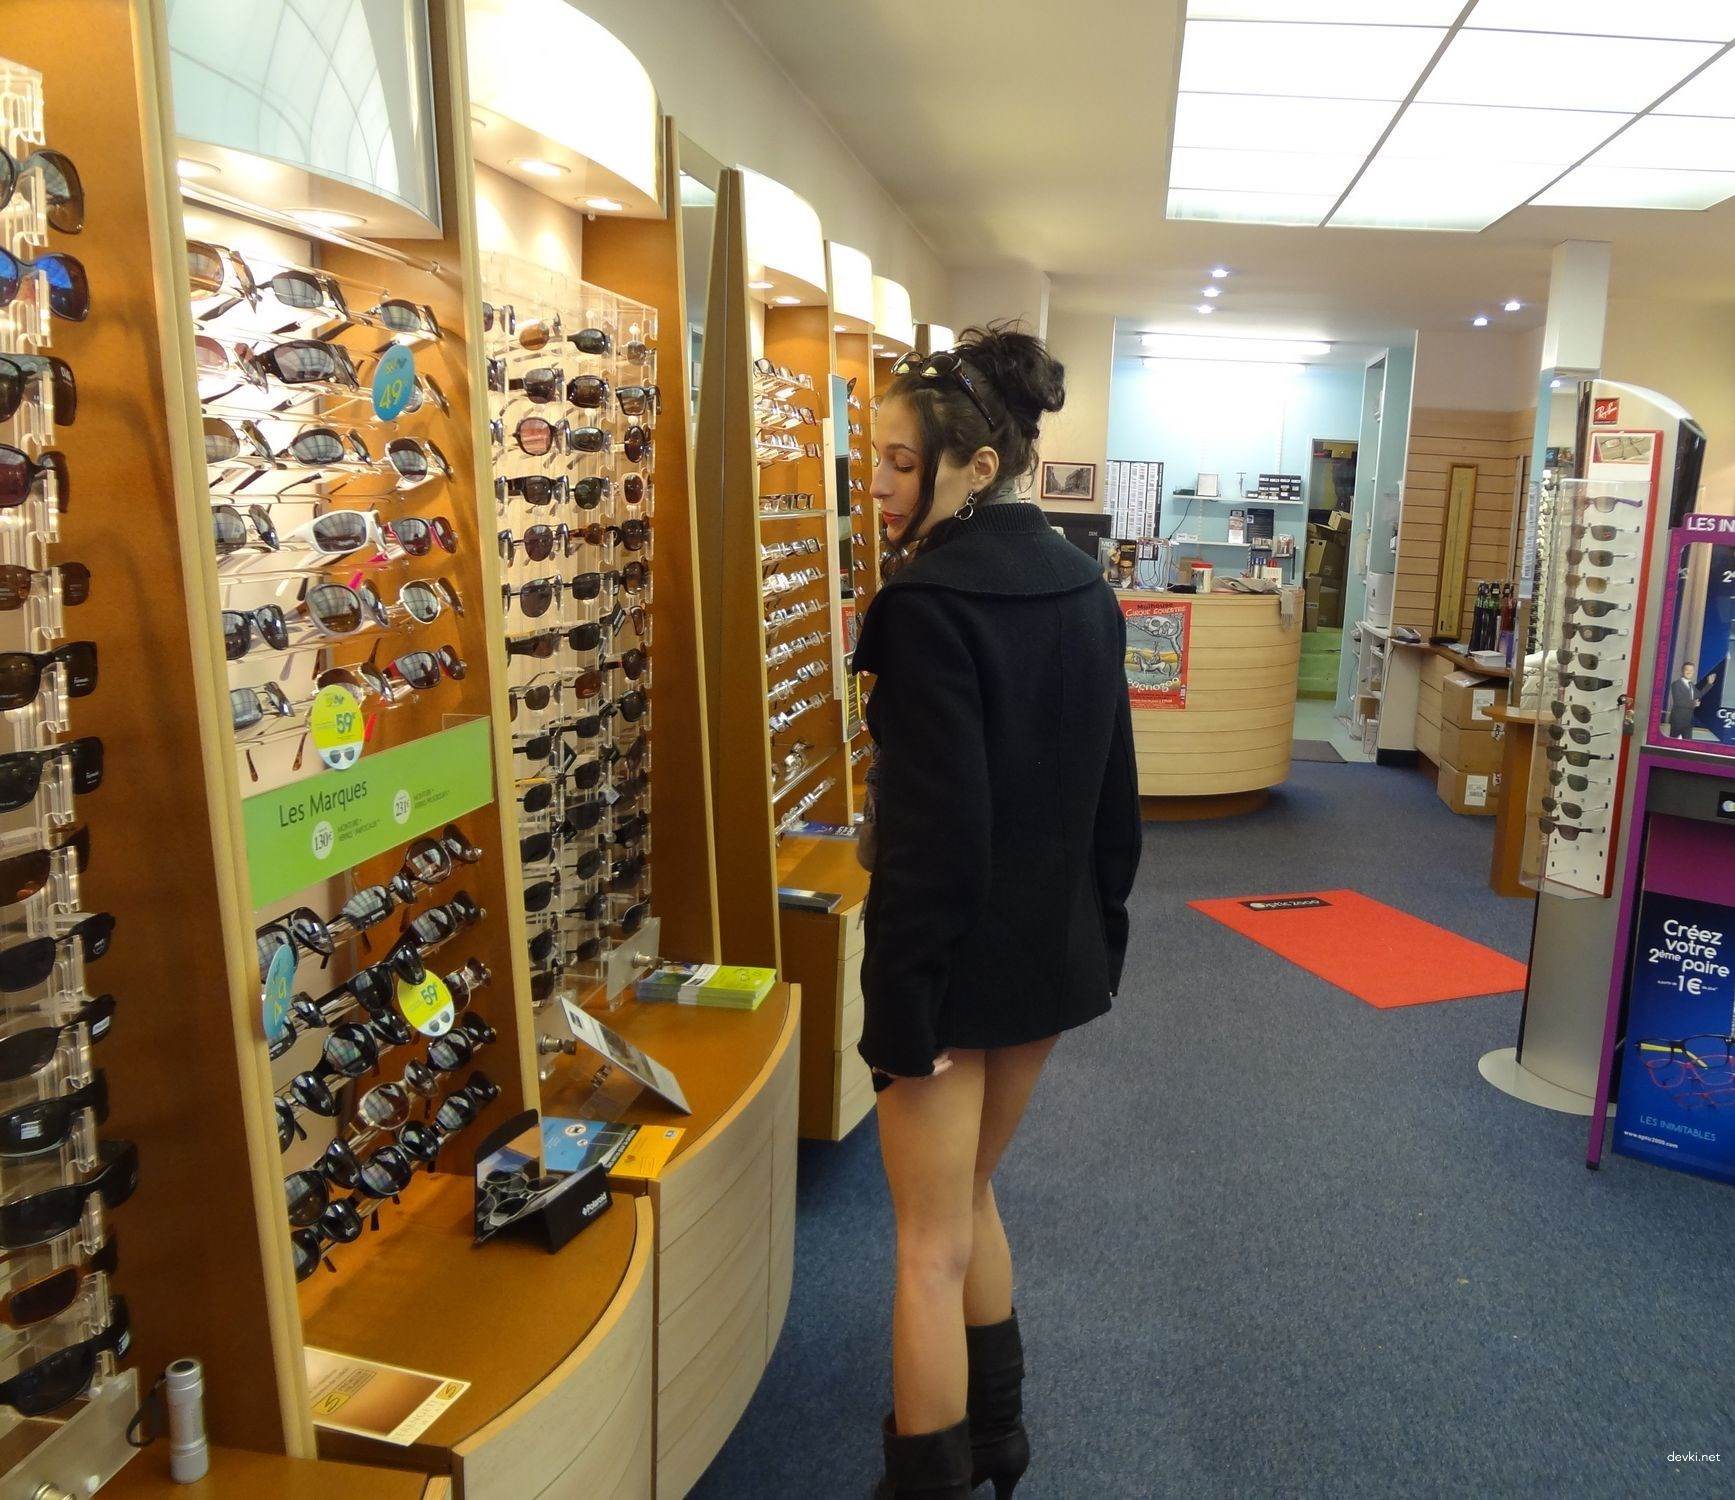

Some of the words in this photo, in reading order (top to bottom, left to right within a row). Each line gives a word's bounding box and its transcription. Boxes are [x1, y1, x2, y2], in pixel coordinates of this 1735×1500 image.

[1687, 516, 1716, 532] LES
[279, 803, 305, 828] Les
[310, 780, 368, 816] Marques
[1664, 919, 1723, 945] Créez
[1665, 938, 1717, 959] votre
[1681, 959, 1730, 978] paire
[1640, 1115, 1658, 1127] LES
[1660, 1121, 1716, 1142] INIMITABLES
